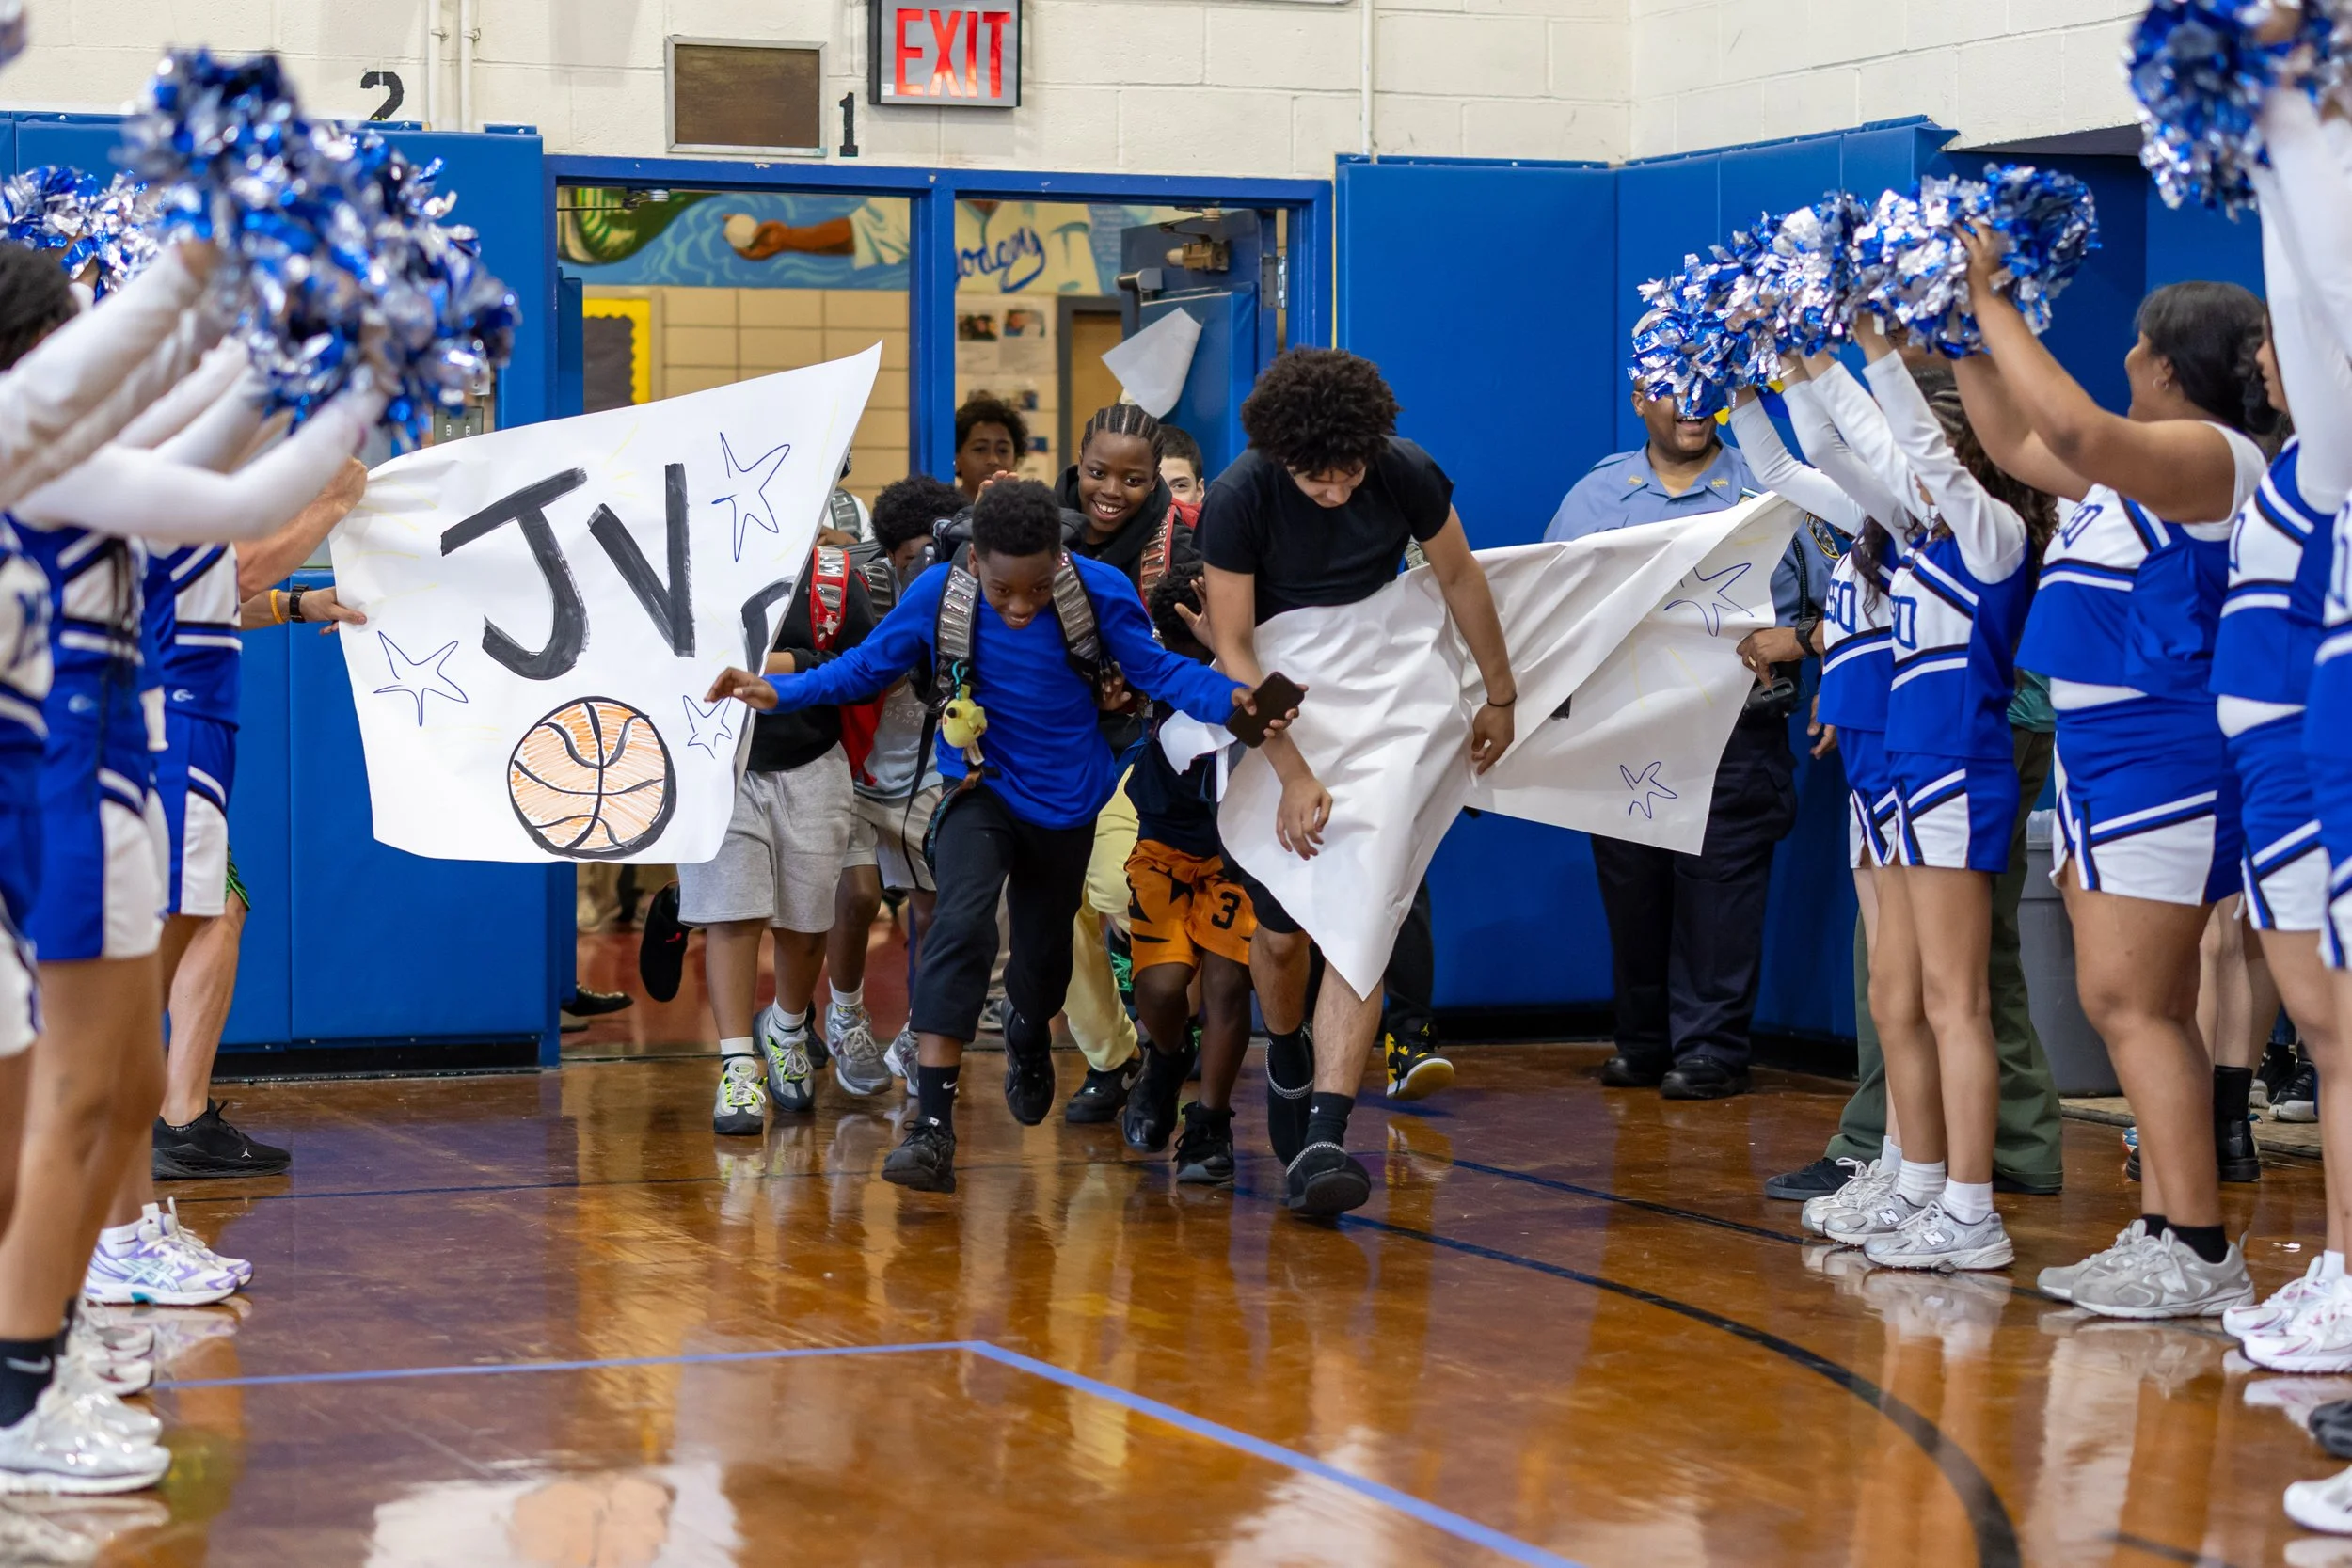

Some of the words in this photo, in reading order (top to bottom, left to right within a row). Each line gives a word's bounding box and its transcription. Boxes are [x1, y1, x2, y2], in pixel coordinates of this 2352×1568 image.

[896, 8, 1011, 99] EXIT
[359, 71, 405, 120] 2
[838, 92, 859, 157] 1
[440, 462, 695, 681] JV
[1211, 890, 1242, 930] 3
